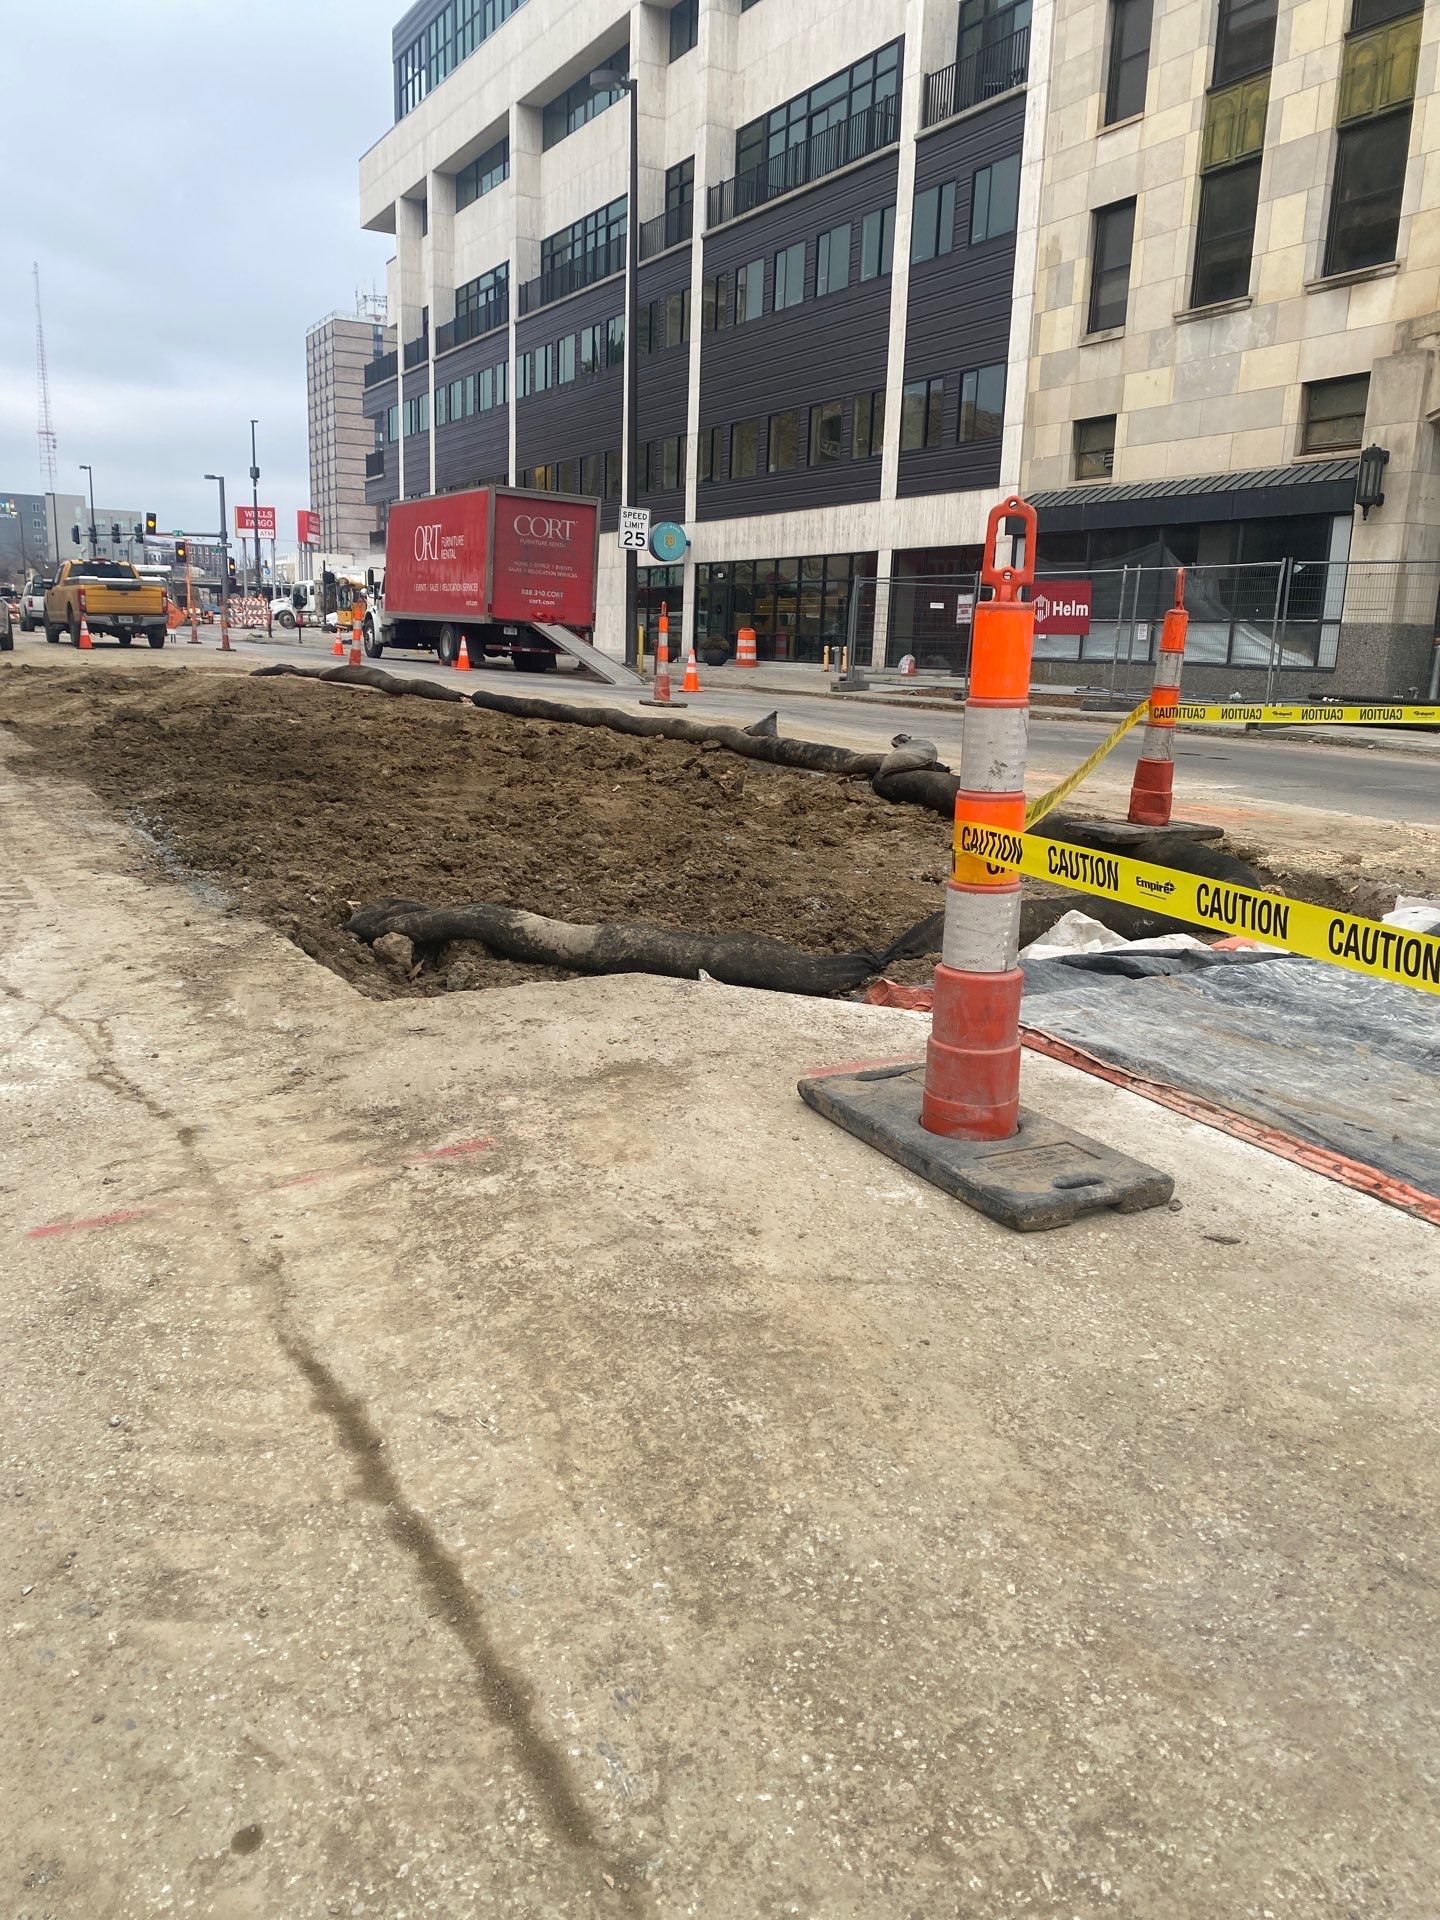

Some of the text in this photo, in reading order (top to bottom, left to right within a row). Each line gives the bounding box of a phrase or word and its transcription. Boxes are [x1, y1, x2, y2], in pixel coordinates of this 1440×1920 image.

[244, 510, 273, 518] WLLS
[622, 511, 648, 520] SPEED
[513, 514, 576, 540] CORT
[624, 521, 644, 529] LIMIT
[259, 529, 273, 537] ATM
[623, 530, 646, 547] 25
[441, 535, 465, 547] FURNITURE
[441, 549, 457, 560] RENTAL
[529, 598, 555, 606] cort.com
[1052, 600, 1089, 617] Helm
[962, 826, 1440, 984] CAUTION CAUTION Empire CAUTION CAUTION
